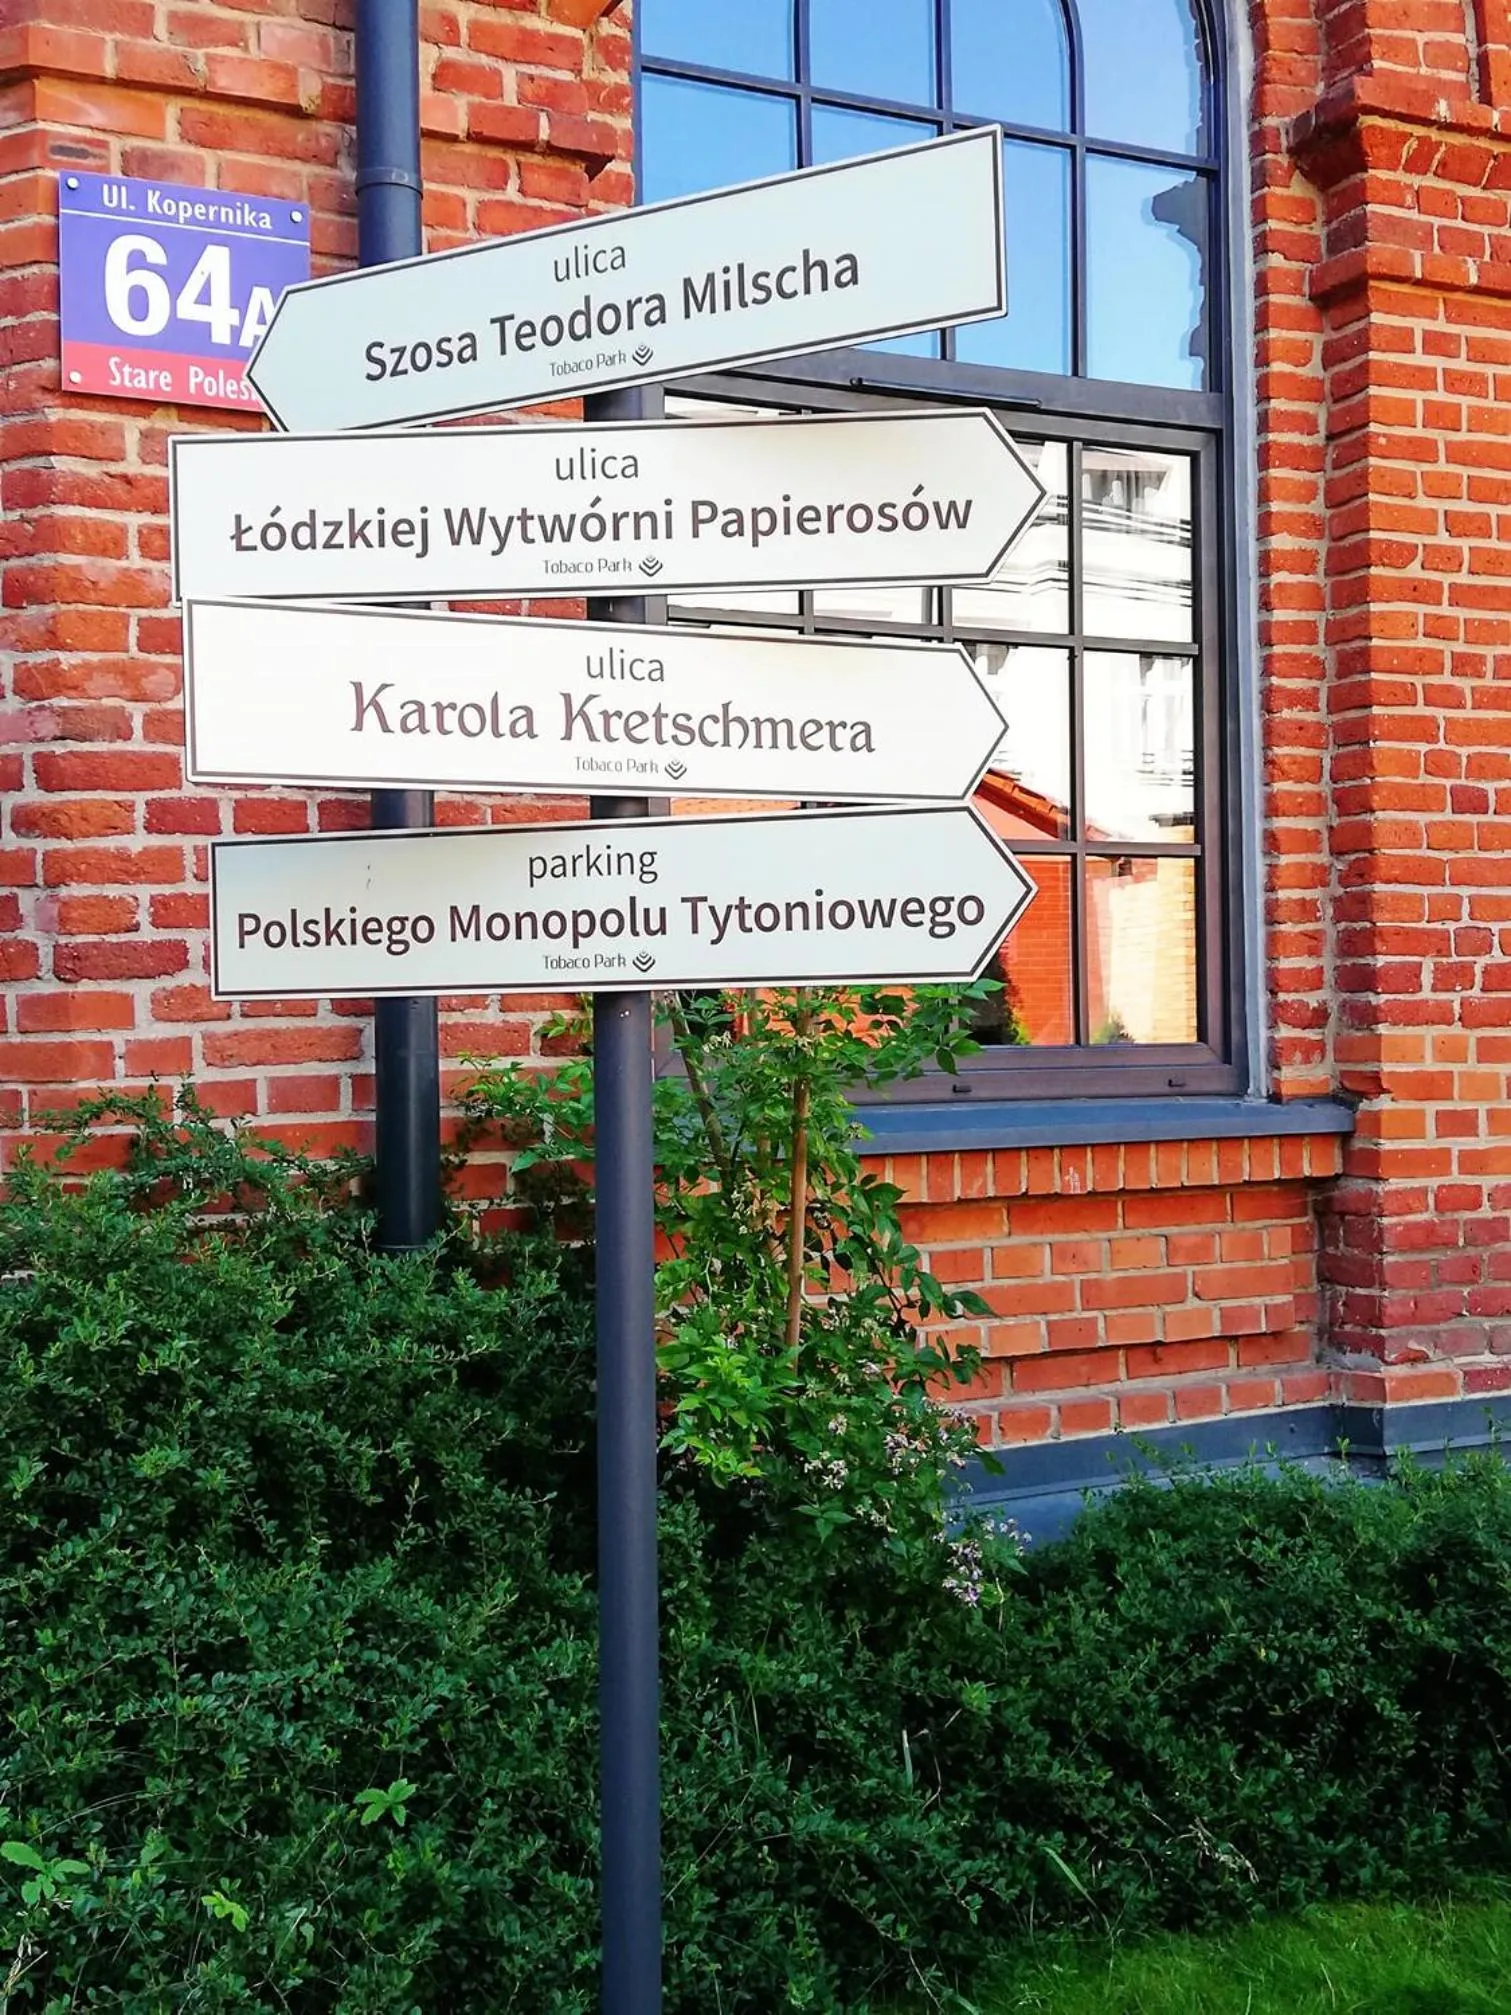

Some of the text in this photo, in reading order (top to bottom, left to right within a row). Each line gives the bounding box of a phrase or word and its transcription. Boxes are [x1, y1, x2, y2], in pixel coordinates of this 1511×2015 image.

[103, 184, 273, 228] Ul. Kopernika
[554, 245, 625, 282] ulica
[366, 249, 858, 381] Szosa Teodora Milscha
[108, 356, 172, 391] Stare
[548, 349, 627, 377] Tobaco Park
[556, 447, 638, 480] ulica
[230, 484, 972, 558] Łódzkiej Wytwórni Papierosów
[543, 557, 633, 575] Tobaco Park
[587, 647, 664, 682] ulica
[350, 681, 875, 753] Karola Kretschmera
[574, 755, 659, 774] Tobaco Park
[529, 845, 658, 888] parking
[239, 888, 985, 955] Polskiego Monopolu Tytoniowego
[543, 952, 627, 970] Tobaco Park
